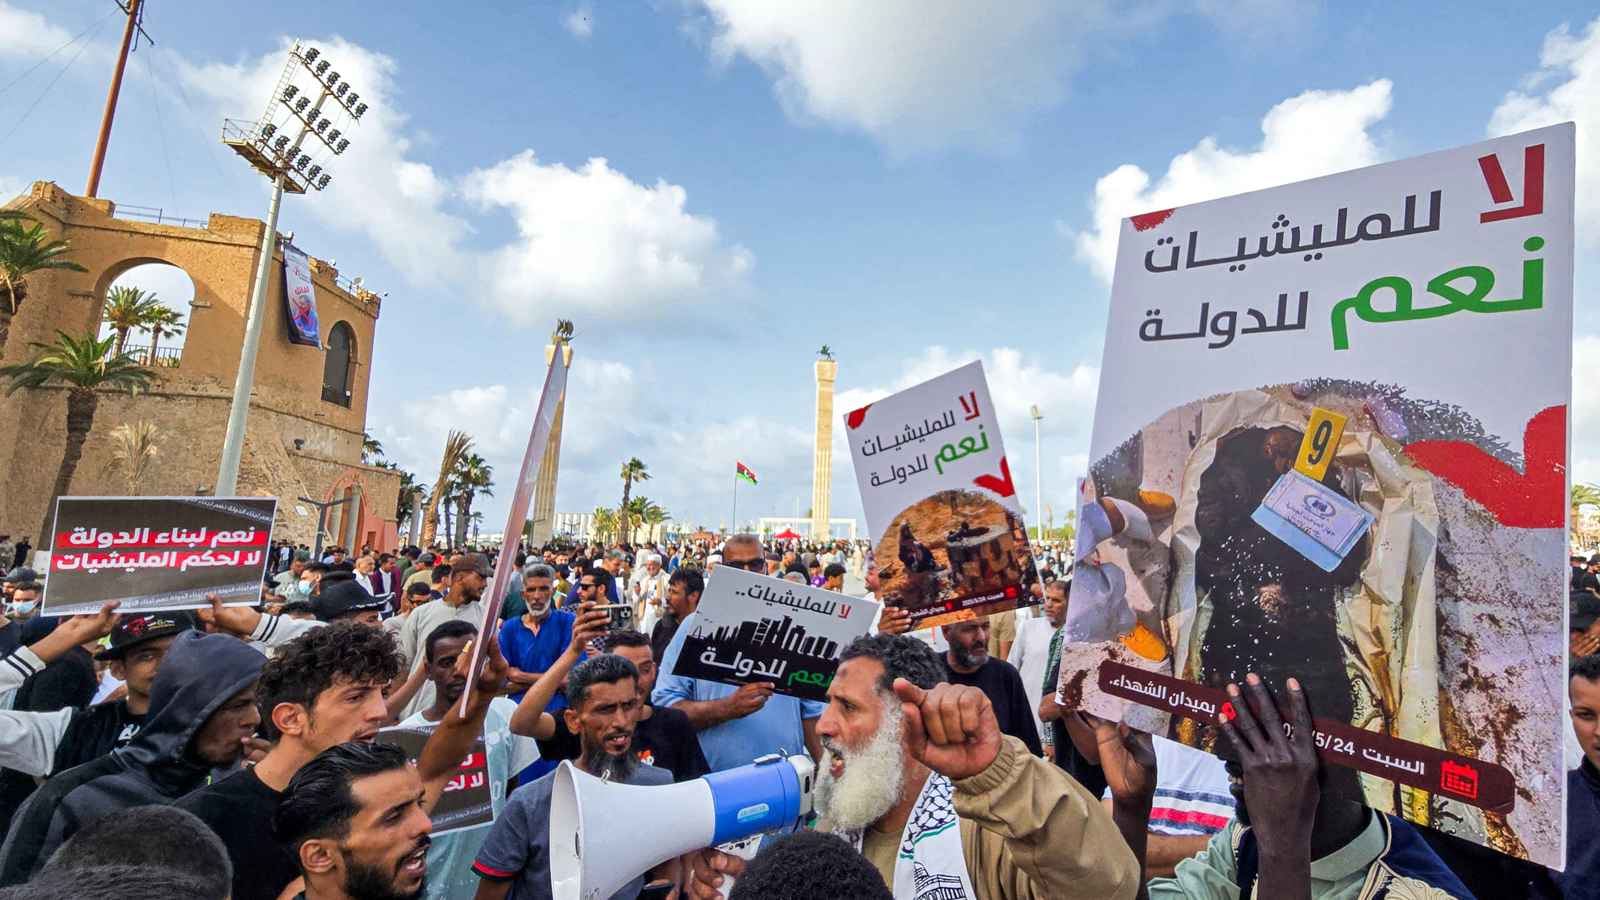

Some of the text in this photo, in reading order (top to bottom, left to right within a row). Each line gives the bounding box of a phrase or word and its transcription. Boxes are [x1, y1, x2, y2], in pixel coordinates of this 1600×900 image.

[1144, 143, 1545, 273] لا للمليشيات
[1138, 236, 1545, 351] نعم للدولة
[861, 389, 981, 457] لا للمليشيات
[870, 423, 990, 487] نعم للدولة
[1308, 420, 1333, 465] 9
[69, 526, 256, 549] نعم لبناء الدولة
[56, 550, 261, 574] لا لحكم المليشيات
[838, 603, 852, 620] لا
[699, 645, 788, 679] للدولة
[1168, 691, 1216, 718] بميدان
[1362, 748, 1425, 776] السبت
[470, 771, 484, 788] لا
